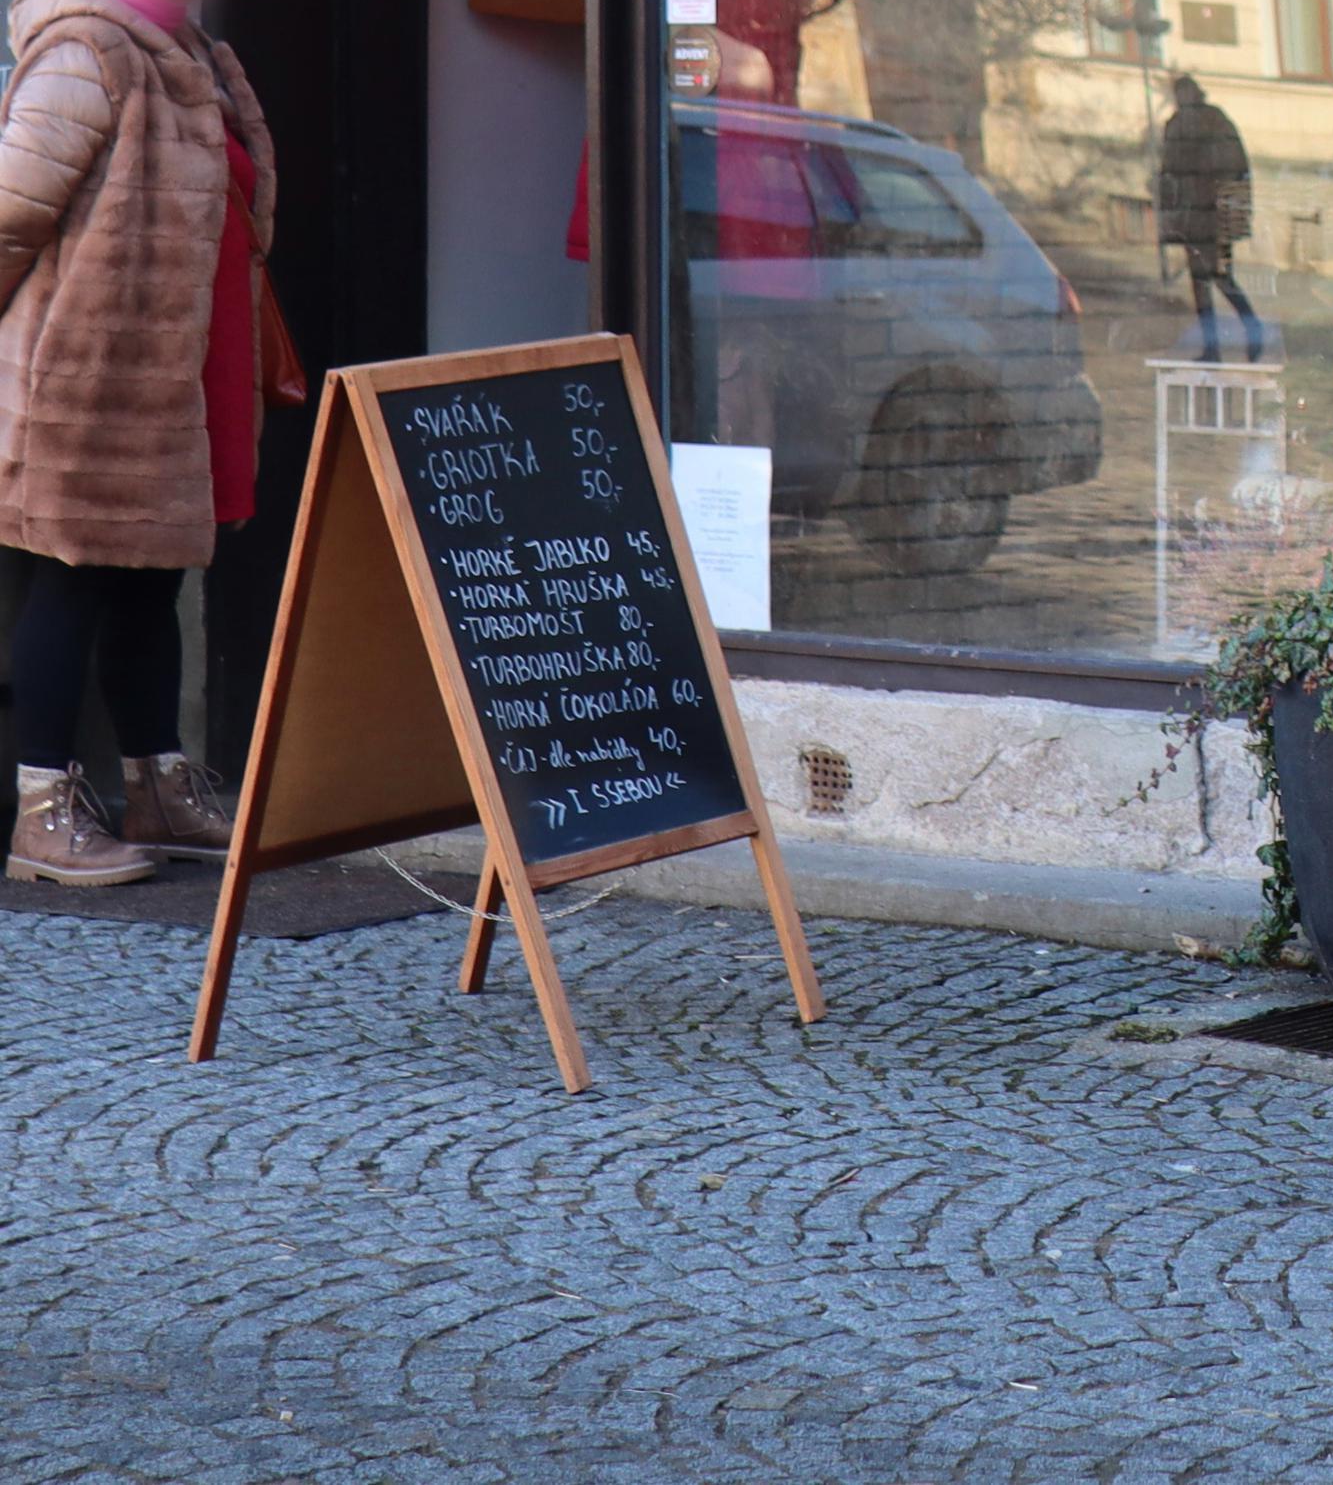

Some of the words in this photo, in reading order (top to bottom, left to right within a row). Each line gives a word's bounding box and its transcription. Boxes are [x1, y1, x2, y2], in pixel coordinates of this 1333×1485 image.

[428, 439, 541, 490] GRIOTKA
[440, 489, 504, 527] GROG
[449, 535, 521, 578] HORKÉ
[524, 536, 611, 572] JABLKO
[542, 570, 630, 607] HRUŠKA
[463, 607, 584, 644] TURBOMOŠT
[476, 641, 628, 687] TURBOHRUŠKA
[560, 678, 660, 721] ČOKOLÁDA
